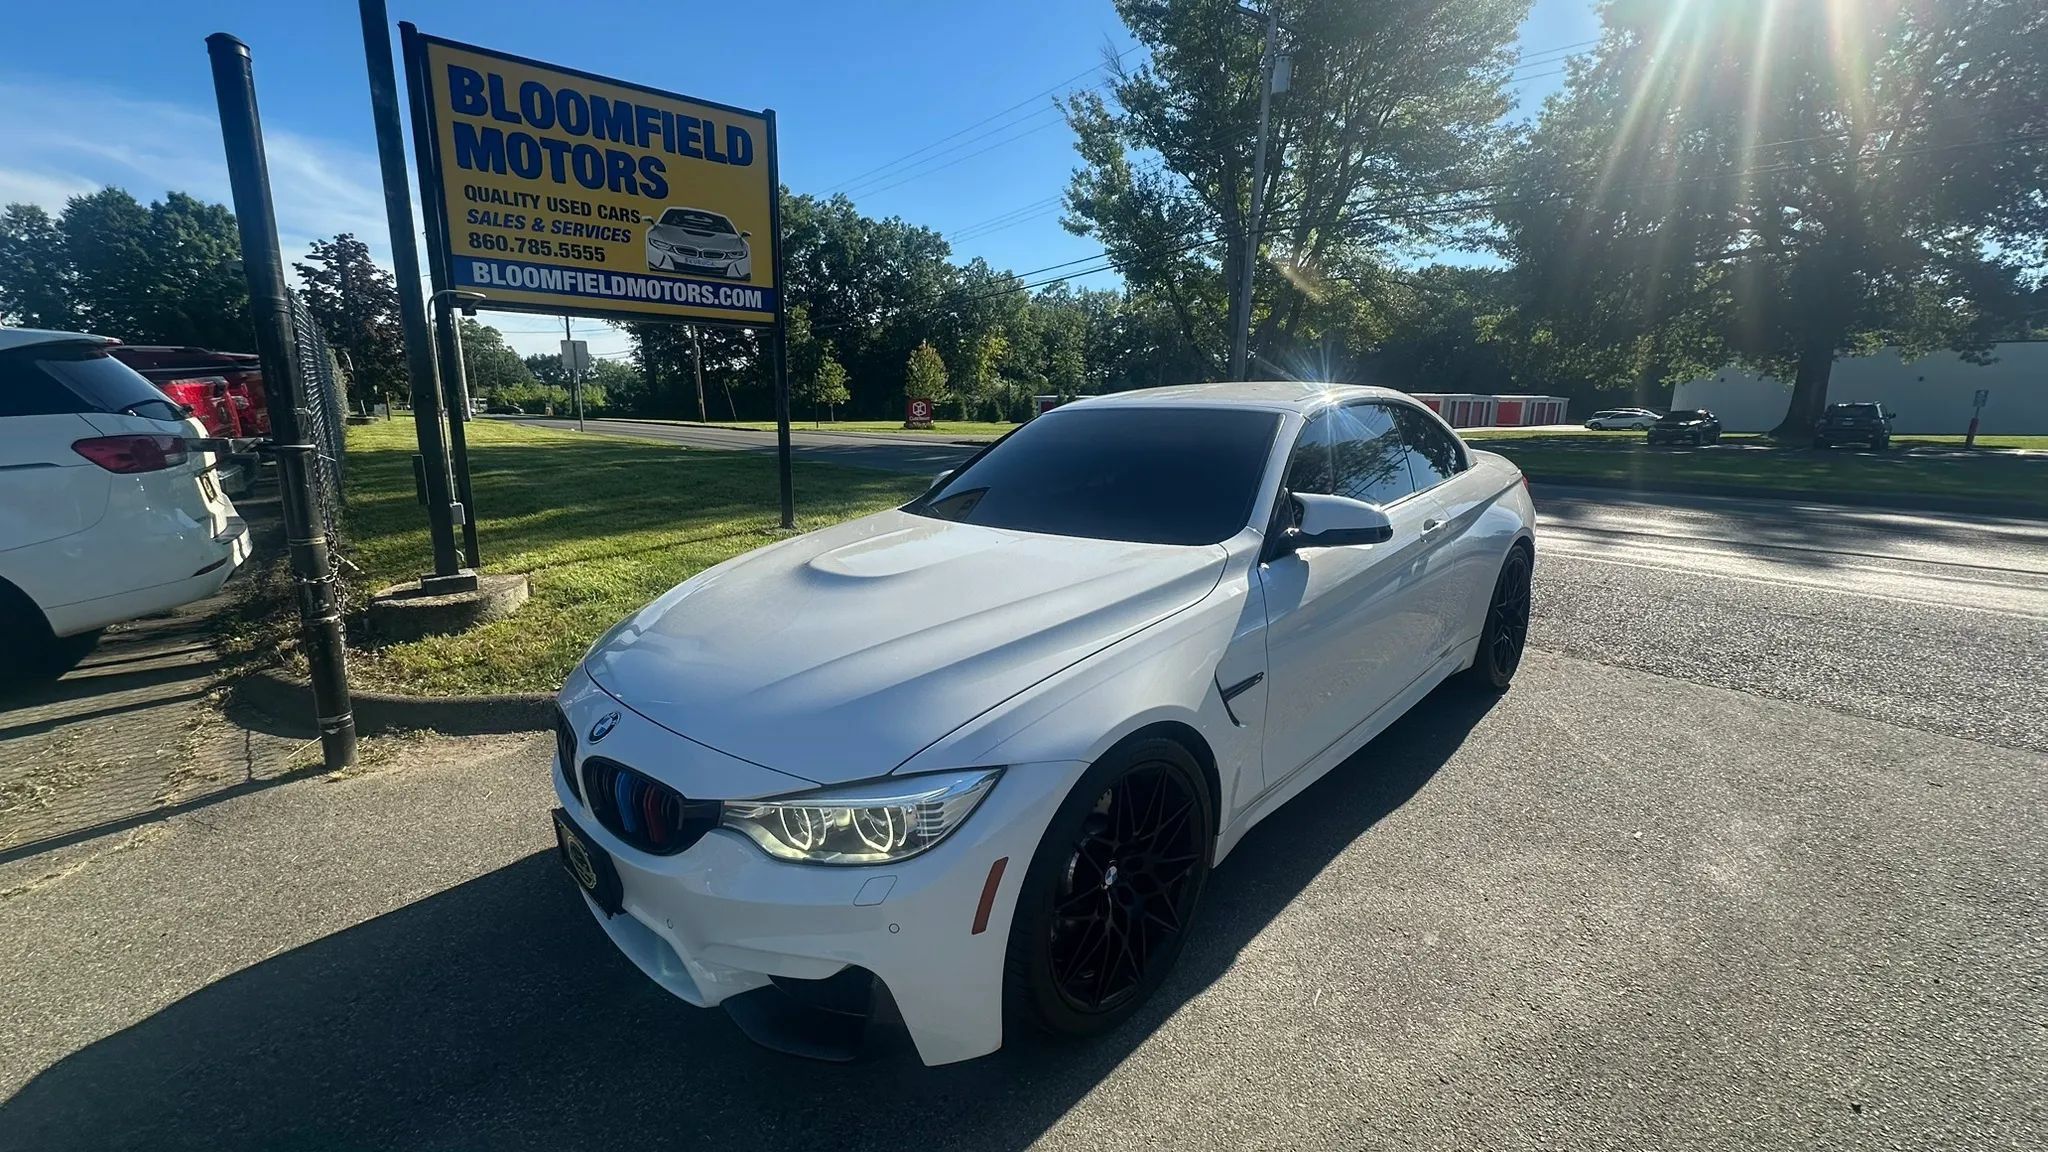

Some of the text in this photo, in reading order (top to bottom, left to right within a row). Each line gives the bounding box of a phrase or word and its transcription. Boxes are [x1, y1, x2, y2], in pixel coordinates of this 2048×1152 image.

[447, 64, 753, 166] BLOOMFIELD
[453, 121, 669, 199] MOTORS
[464, 184, 641, 224] QUALITY USED CARS
[467, 208, 632, 244] SALES & SERVICES
[468, 232, 606, 262] 860.785.5555
[472, 261, 762, 309] BLOOMFIELDMOTORS.COM
